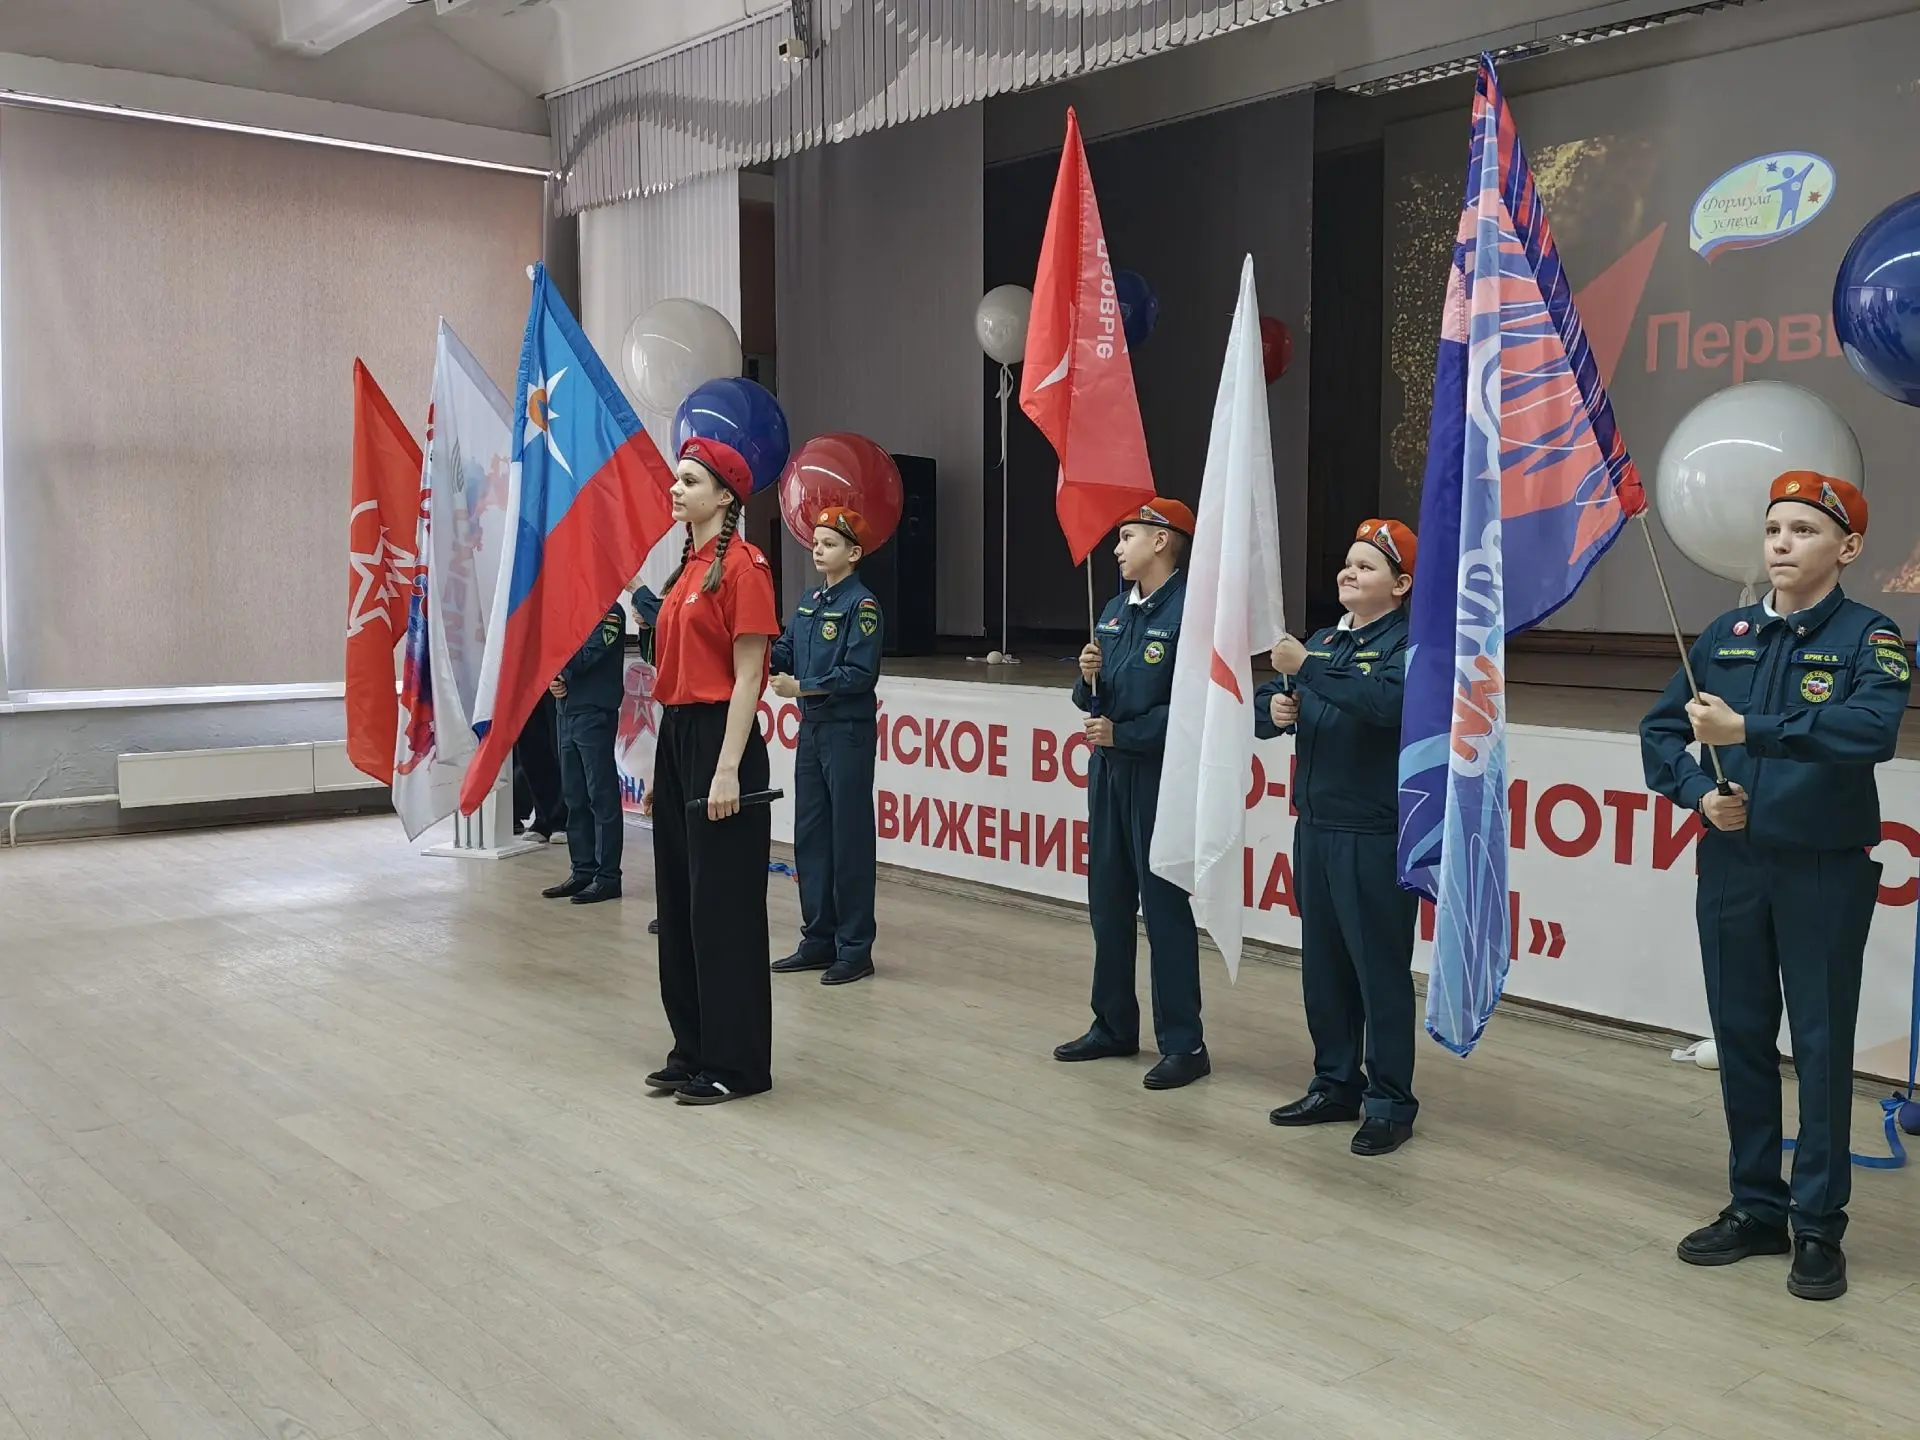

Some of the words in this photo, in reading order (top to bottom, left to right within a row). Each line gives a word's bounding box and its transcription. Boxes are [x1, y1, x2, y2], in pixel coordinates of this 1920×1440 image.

[1703, 194, 1771, 212] Формула
[1709, 215, 1759, 233] успеха
[878, 789, 1089, 876] ВИЖЕНИЕ
